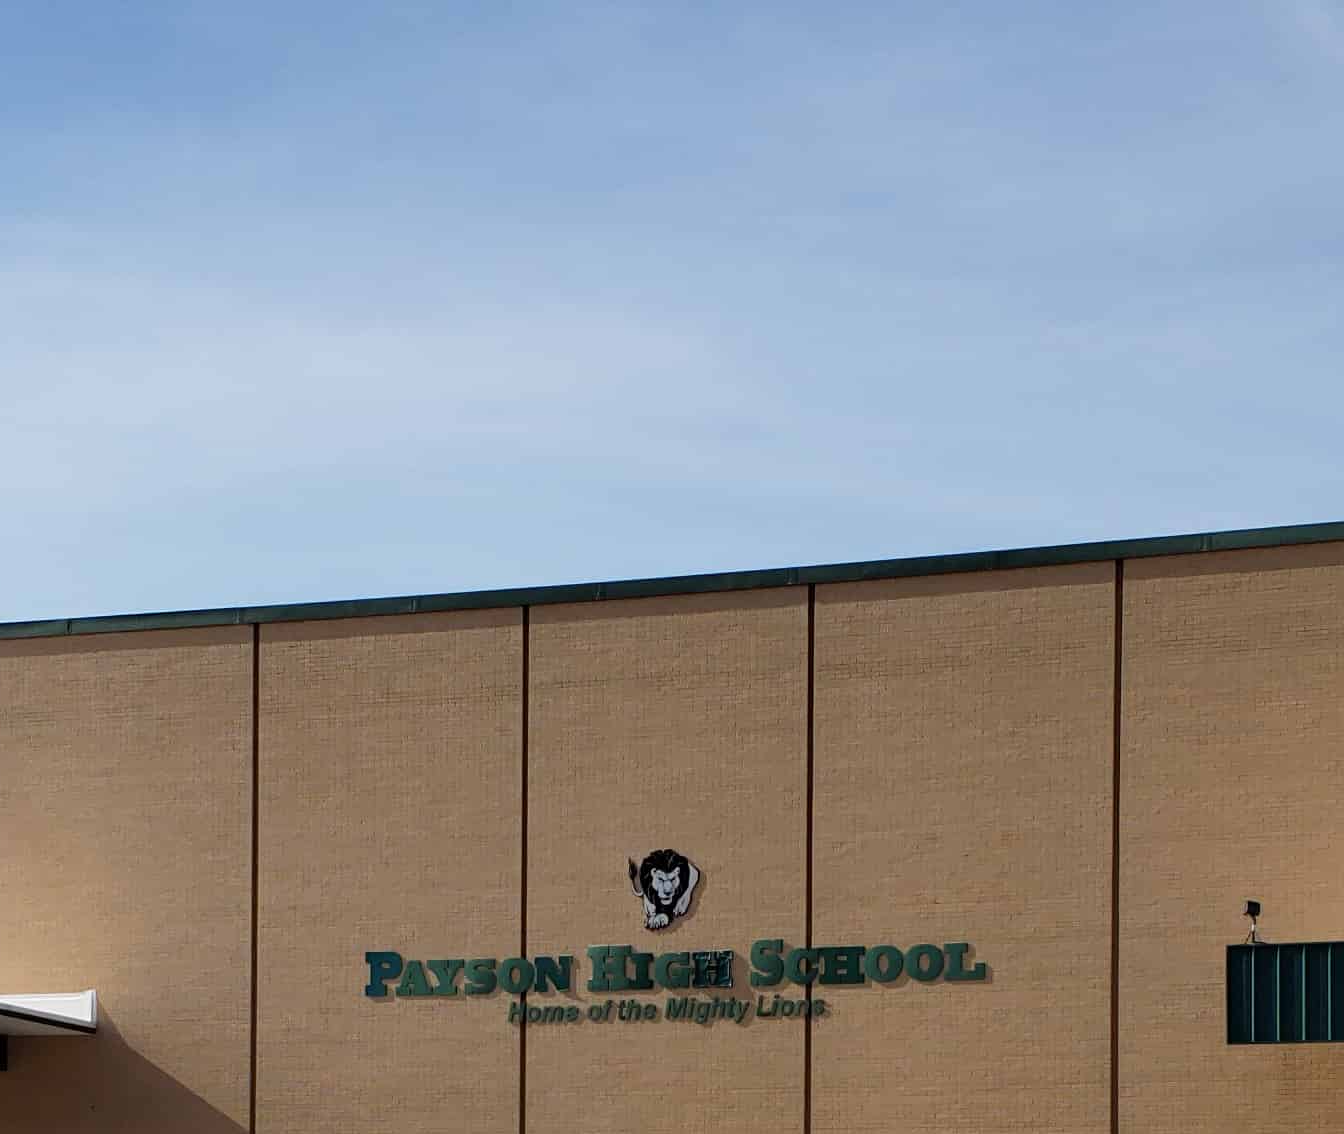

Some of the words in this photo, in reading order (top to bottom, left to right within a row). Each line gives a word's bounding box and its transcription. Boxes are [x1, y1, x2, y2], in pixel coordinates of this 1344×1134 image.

[364, 951, 573, 997] PAYSON
[587, 944, 734, 991] HIGH
[750, 938, 987, 986] SCHOOL
[507, 1000, 580, 1024] Home
[587, 999, 614, 1023] of
[615, 998, 657, 1020] the
[663, 997, 750, 1024] Mighty
[755, 995, 826, 1017] Lions
